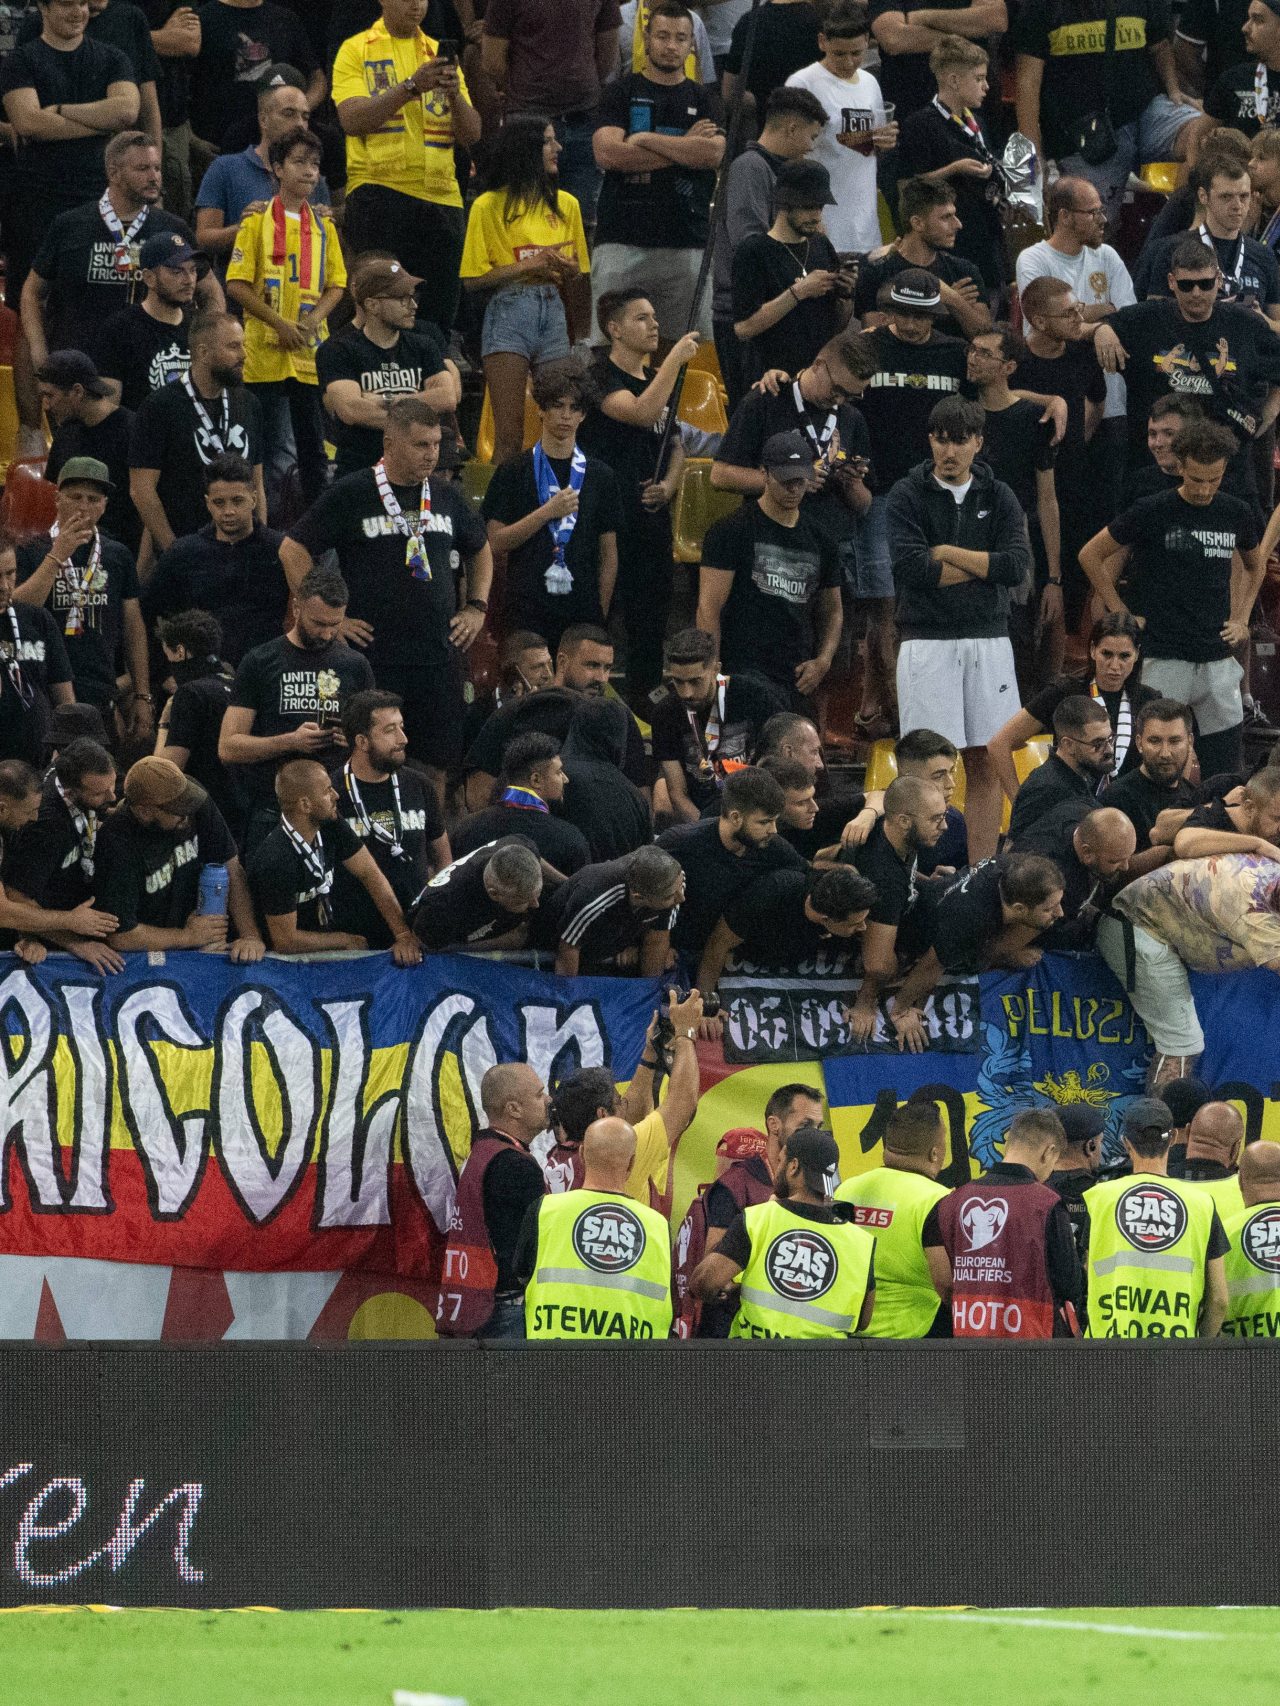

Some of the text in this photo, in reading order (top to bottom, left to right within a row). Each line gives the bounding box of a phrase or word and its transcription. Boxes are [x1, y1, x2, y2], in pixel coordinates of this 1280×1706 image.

[282, 671, 316, 683] UNITI
[283, 684, 316, 697] SUB
[282, 698, 340, 713] TRICOLOR
[855, 1209, 889, 1226] SAS
[1125, 1195, 1177, 1227] SAS
[582, 1214, 636, 1249] SAS
[1125, 1221, 1176, 1238] TEAM
[582, 1240, 634, 1261] TEAM
[774, 1239, 830, 1279] SAS
[955, 1256, 1006, 1269] EUROPEAN
[773, 1265, 823, 1292] TEAM
[953, 1269, 1012, 1284] UALIFIERS
[953, 1301, 1021, 1333] HOTO
